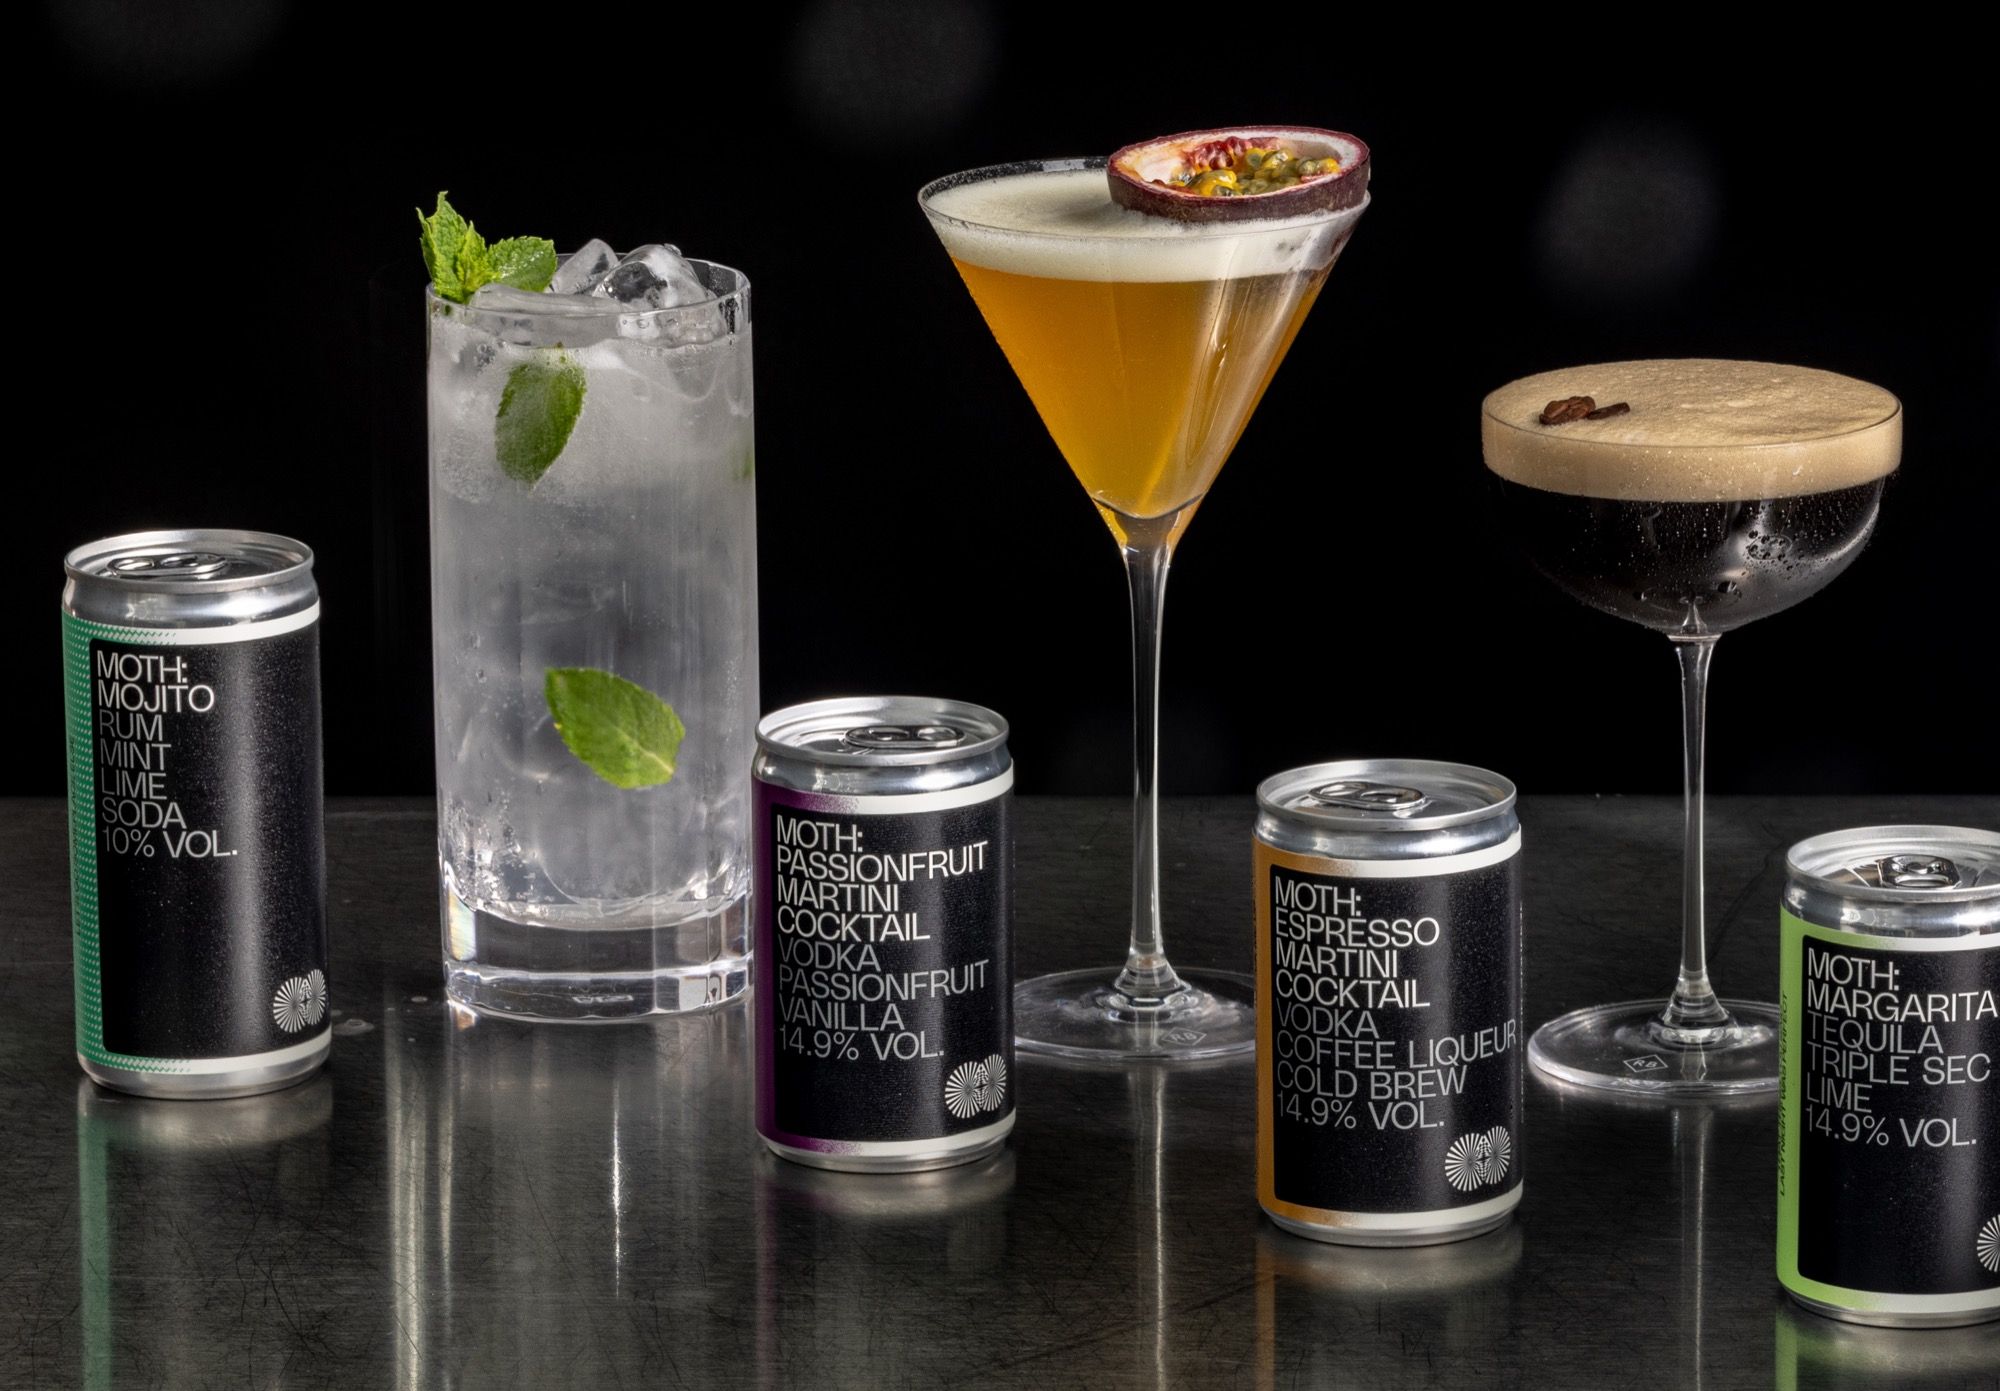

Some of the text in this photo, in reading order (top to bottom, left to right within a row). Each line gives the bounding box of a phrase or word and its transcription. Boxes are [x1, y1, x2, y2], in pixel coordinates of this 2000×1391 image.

[97, 650, 187, 683] MOTH:
[98, 679, 215, 712] MOJITO
[100, 708, 163, 741] RUM
[100, 738, 172, 771] MINT
[101, 767, 167, 800] LIME
[102, 797, 187, 829] SODA
[777, 814, 863, 852] MOTH:
[102, 826, 238, 858] 10% VOL.
[777, 840, 988, 883] PASSIONFRUIT
[777, 874, 899, 912] MARTINI
[1275, 876, 1361, 916] MOTH:
[777, 905, 931, 942] COCKTAIL
[1275, 907, 1440, 947] ESPRESSO
[778, 934, 881, 972] VODKA
[1276, 937, 1397, 978] MARTINI
[1808, 947, 1899, 991] MOTH:
[779, 959, 989, 1001] PASSIONFRUIT
[1276, 968, 1430, 1009] COCKTAIL
[779, 993, 905, 1031] VANILLA
[1276, 997, 1380, 1039] VODKA
[1808, 979, 1998, 1022] MARGARITA
[779, 1024, 945, 1061] 14.9% VOL.
[1277, 1018, 1516, 1069] COFFEE LIQUEUR
[1808, 1010, 1944, 1054] TEQUILA
[1277, 1060, 1468, 1100] COLD BREW
[1807, 1041, 1991, 1085] TRIPLE SEC
[1278, 1090, 1444, 1130] 14.9% VOL.
[1807, 1072, 1872, 1113] LIME
[1806, 1104, 1977, 1147] 14.9% VOL.
